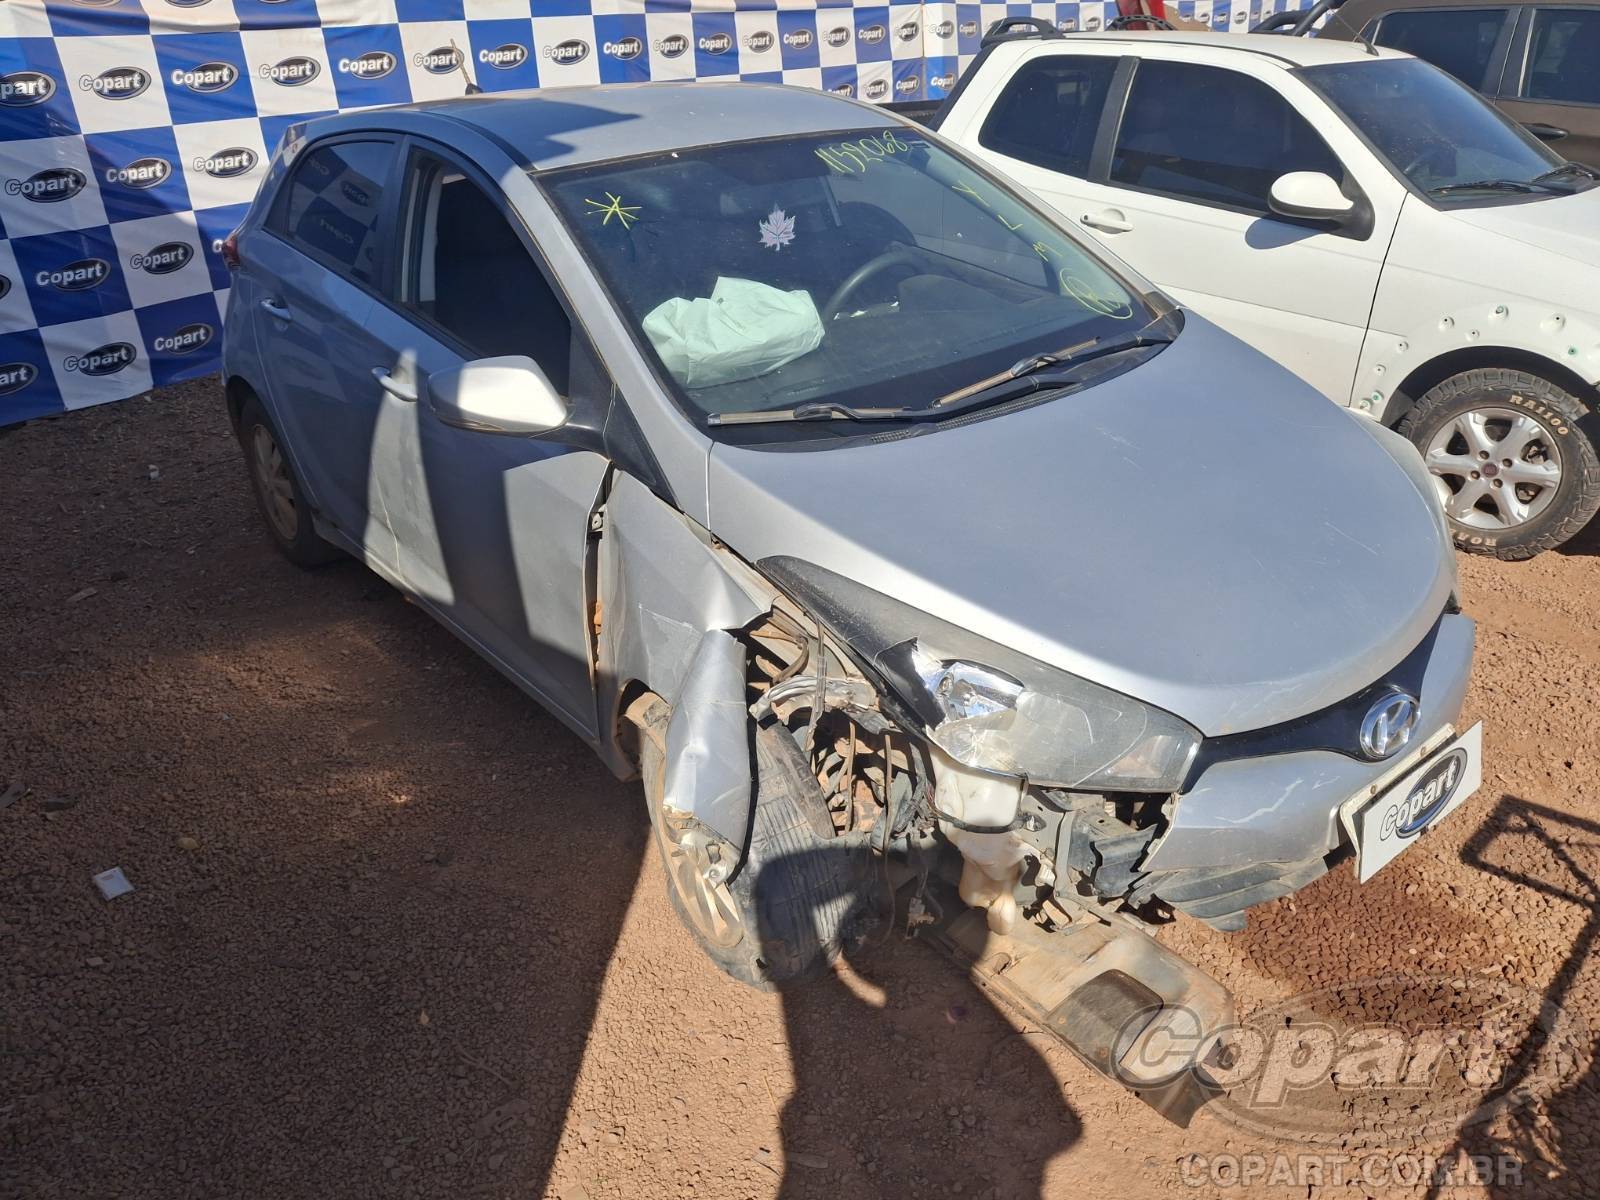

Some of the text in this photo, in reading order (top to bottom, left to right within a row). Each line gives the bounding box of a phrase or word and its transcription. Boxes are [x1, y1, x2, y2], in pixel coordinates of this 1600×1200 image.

[699, 34, 729, 51] Copart
[744, 33, 771, 49] Copart
[783, 31, 810, 46] Copart
[823, 29, 847, 43] Copart
[858, 26, 882, 40] Copart
[542, 43, 583, 61] Copart
[603, 39, 639, 57] Copart
[654, 36, 684, 54] Copart
[338, 54, 390, 76] Copart
[413, 48, 458, 69] Copart
[479, 46, 522, 66] Copart
[171, 64, 230, 90] Copart
[259, 62, 313, 84] Copart
[79, 73, 141, 97] Copart
[895, 78, 917, 92] Copart
[106, 161, 164, 184] Copart
[193, 154, 249, 175] Copart
[5, 174, 77, 197] Copart
[130, 246, 185, 272] Copart
[36, 260, 104, 288] Copart
[154, 324, 207, 351] Copart
[63, 346, 129, 374] Copart
[1379, 757, 1457, 841] Copart
